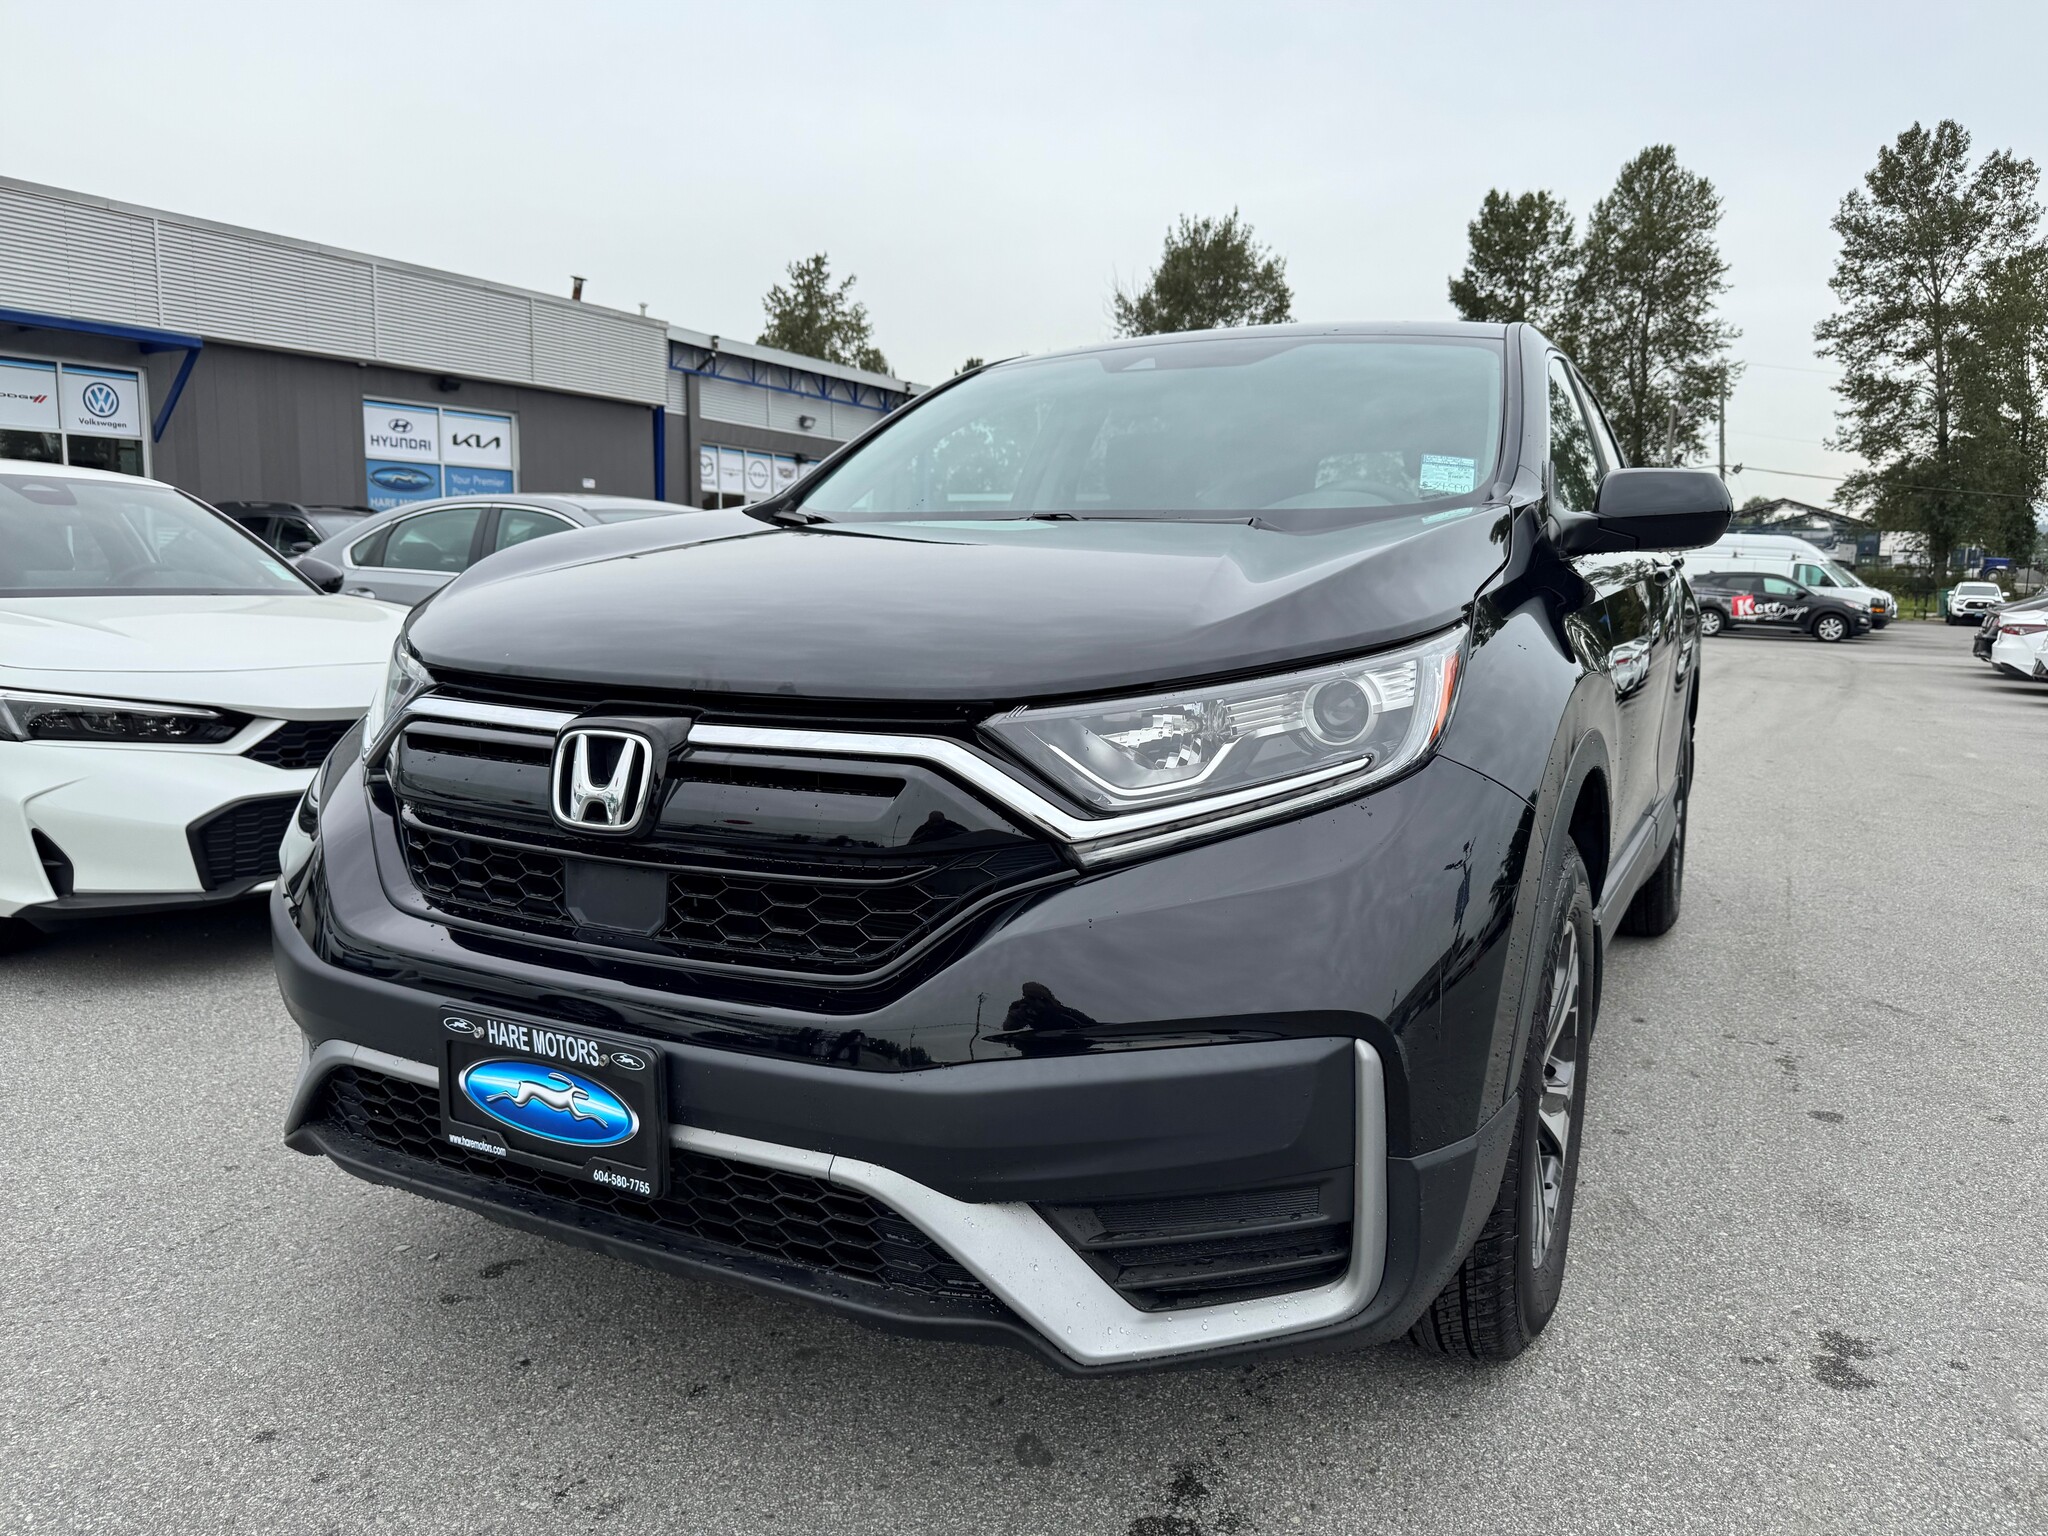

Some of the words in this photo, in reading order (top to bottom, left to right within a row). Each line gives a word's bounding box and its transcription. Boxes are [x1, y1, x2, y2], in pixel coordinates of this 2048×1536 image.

[78, 417, 127, 428] Volkswagen
[370, 434, 432, 451] HYUNDAI
[452, 432, 501, 449] KIA
[451, 474, 470, 485] Your
[473, 474, 505, 487] Premier
[370, 497, 397, 508] HARE
[1736, 598, 1780, 617] Kerr
[486, 1019, 531, 1052] HARE
[532, 1028, 600, 1067] MOTORS
[448, 1133, 507, 1157] www.haremotors.com
[593, 1169, 650, 1195] 604-580-7755
